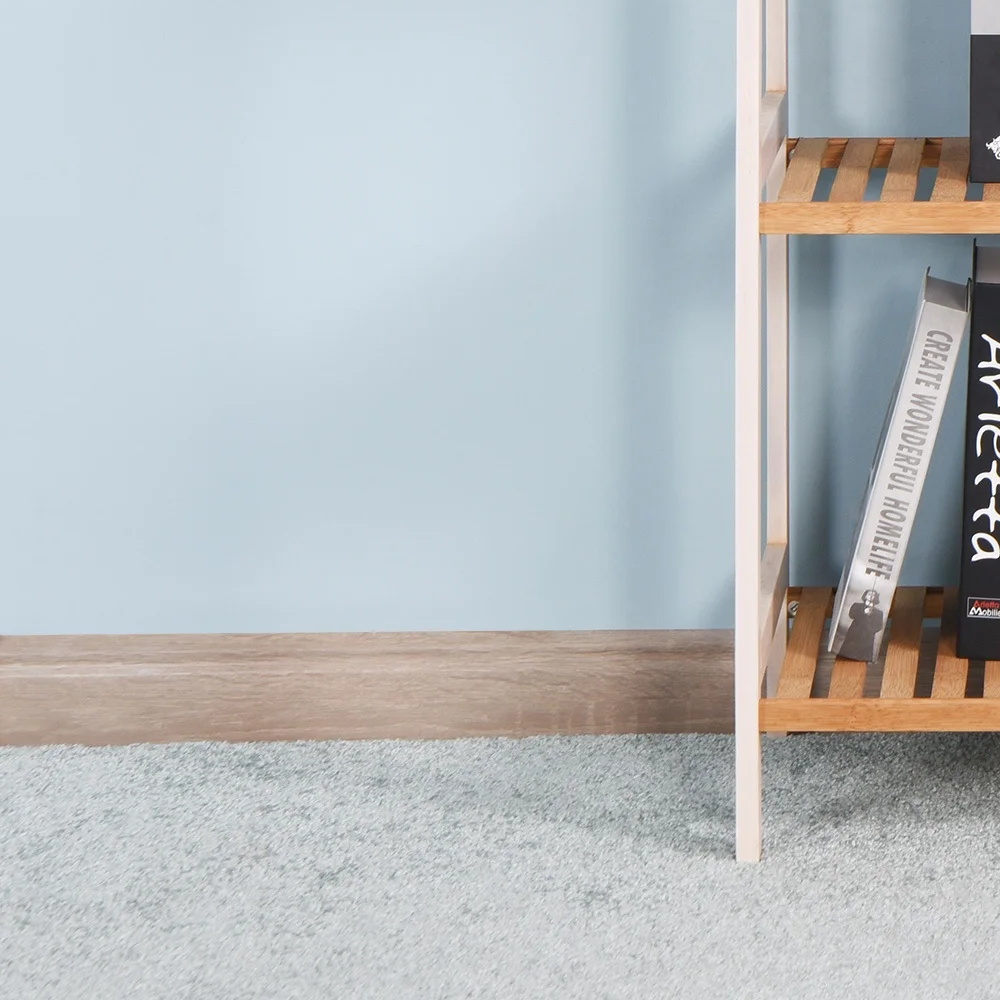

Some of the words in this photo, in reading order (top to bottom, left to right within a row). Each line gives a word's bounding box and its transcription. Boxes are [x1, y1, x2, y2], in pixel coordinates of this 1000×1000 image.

[915, 329, 953, 390] CREATE
[884, 393, 938, 494] WONDERFUL
[865, 496, 908, 580] HOMELIFE
